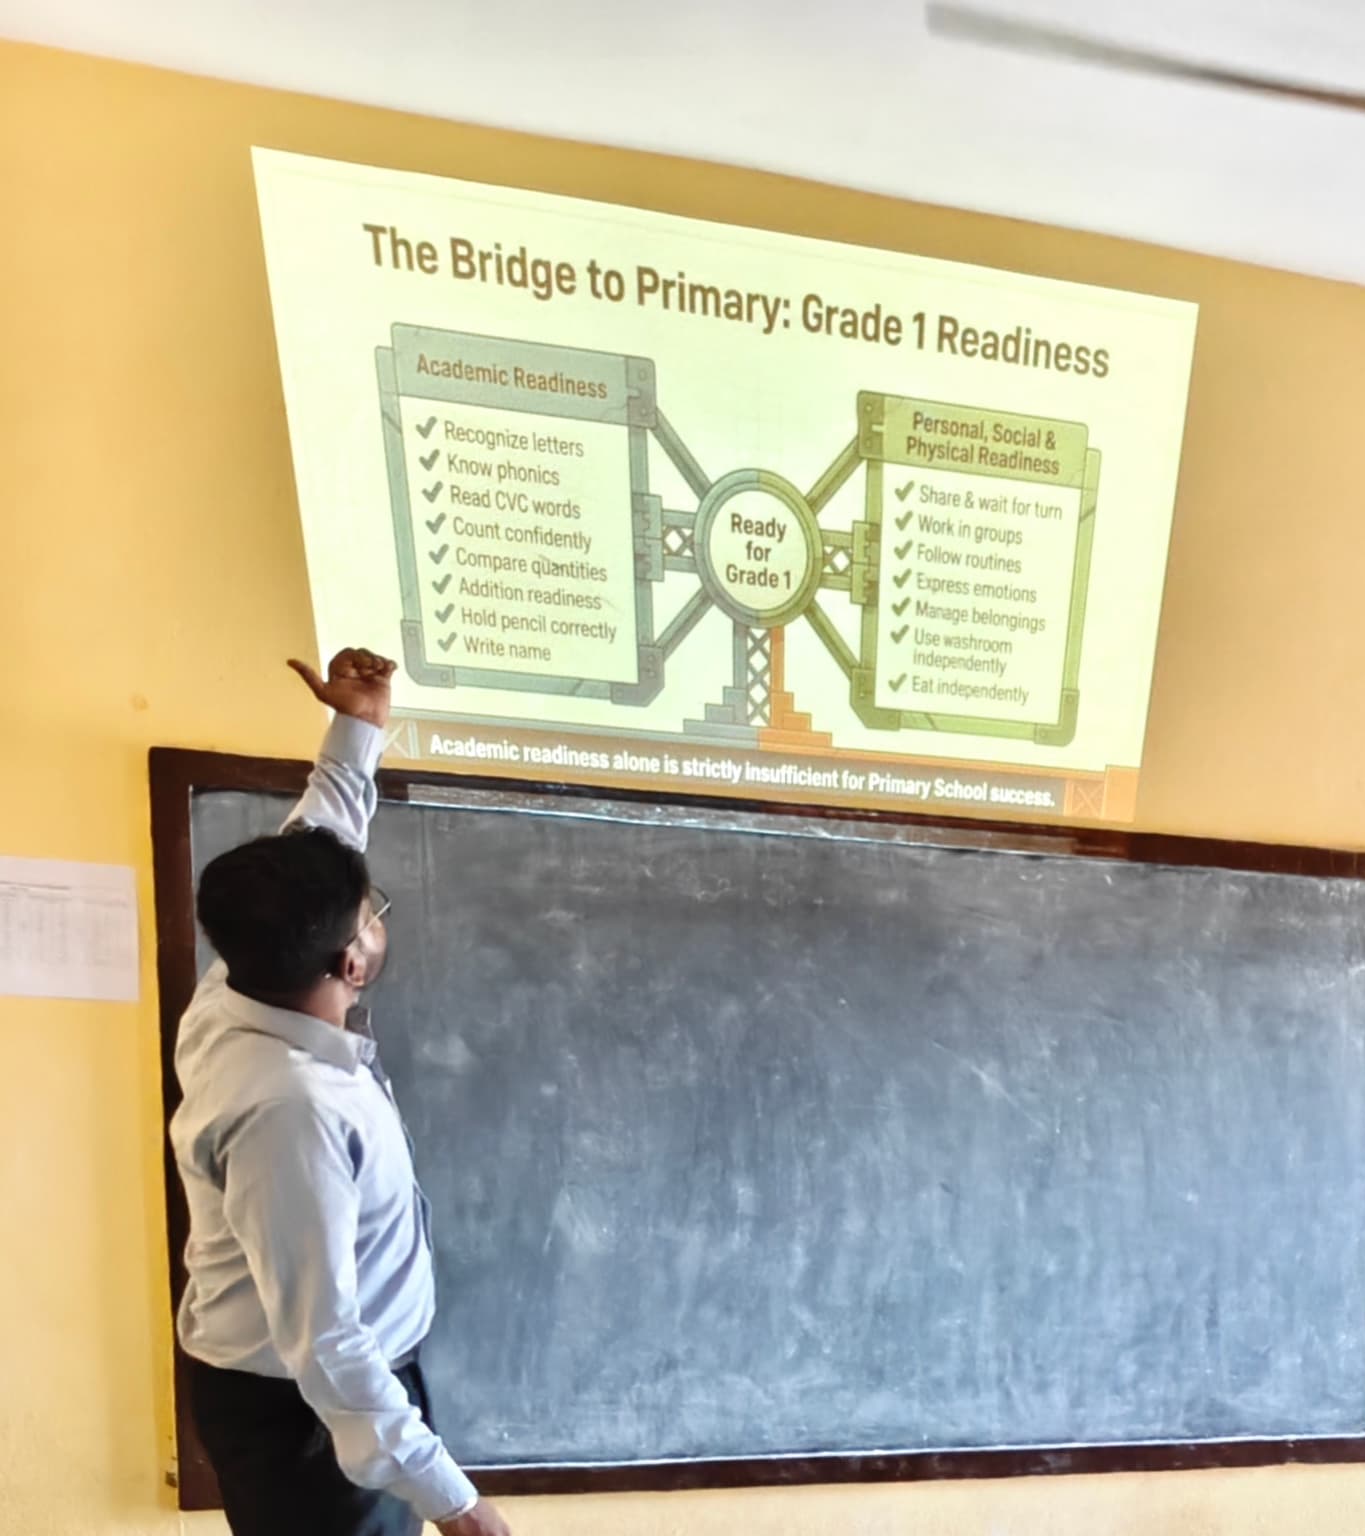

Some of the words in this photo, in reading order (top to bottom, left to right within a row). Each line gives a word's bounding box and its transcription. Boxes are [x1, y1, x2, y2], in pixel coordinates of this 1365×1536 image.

[362, 223, 440, 275] The
[449, 237, 577, 300] Bridge
[587, 258, 626, 302] to
[636, 265, 792, 335] Primary:
[802, 293, 903, 346] Grade
[912, 312, 926, 350] 1
[937, 314, 1110, 378] Readiness
[416, 353, 509, 387] Academic
[513, 367, 608, 399] Readiness
[444, 420, 529, 450] Recognize
[532, 432, 585, 457] letters
[913, 411, 988, 443] Personal,
[992, 423, 1041, 448] Social
[1045, 431, 1056, 450] &
[447, 453, 492, 477] Know
[497, 460, 560, 486] phonics
[906, 436, 974, 465] Physical
[978, 446, 1060, 476] Readiness
[450, 484, 491, 508] Read
[495, 490, 529, 514] CVC
[532, 494, 581, 519] words
[919, 484, 962, 507] Share
[964, 491, 975, 509] &
[978, 495, 1008, 514] wait
[1011, 497, 1031, 516] for
[1034, 502, 1063, 520] turn
[453, 516, 501, 541] Count
[505, 526, 592, 555] confidently
[731, 513, 787, 543] Ready
[918, 513, 954, 537] Work
[958, 520, 971, 538] in
[974, 527, 1023, 547] groups
[456, 547, 528, 574] Compare
[531, 556, 608, 582] quantities
[745, 540, 772, 562] for
[916, 543, 962, 564] Follow
[965, 549, 1022, 574] routines
[458, 577, 524, 600] Addition
[527, 586, 602, 610] readiness
[726, 564, 779, 588] Grade
[783, 570, 791, 590] 1
[916, 571, 970, 595] Express
[973, 582, 1038, 603] emotions
[461, 607, 496, 627] Hold
[501, 613, 547, 633] pencil
[550, 618, 617, 643] correctly
[915, 600, 969, 626] Manage
[972, 608, 1046, 634] belongings
[464, 635, 505, 656] Write
[509, 643, 551, 661] name
[914, 627, 941, 647] Use
[943, 633, 1013, 654] washroom
[913, 649, 1008, 678] independently
[912, 675, 935, 693] Eat
[937, 677, 1030, 705] independently
[430, 733, 520, 761] Academic
[523, 745, 610, 769] readiness
[613, 750, 661, 773] alone
[664, 753, 679, 775] is
[682, 756, 744, 784] strictly
[745, 760, 838, 790] insufficient
[841, 769, 866, 791] for
[868, 772, 933, 802] Primary
[934, 777, 989, 802] School
[990, 784, 1056, 807] success.
